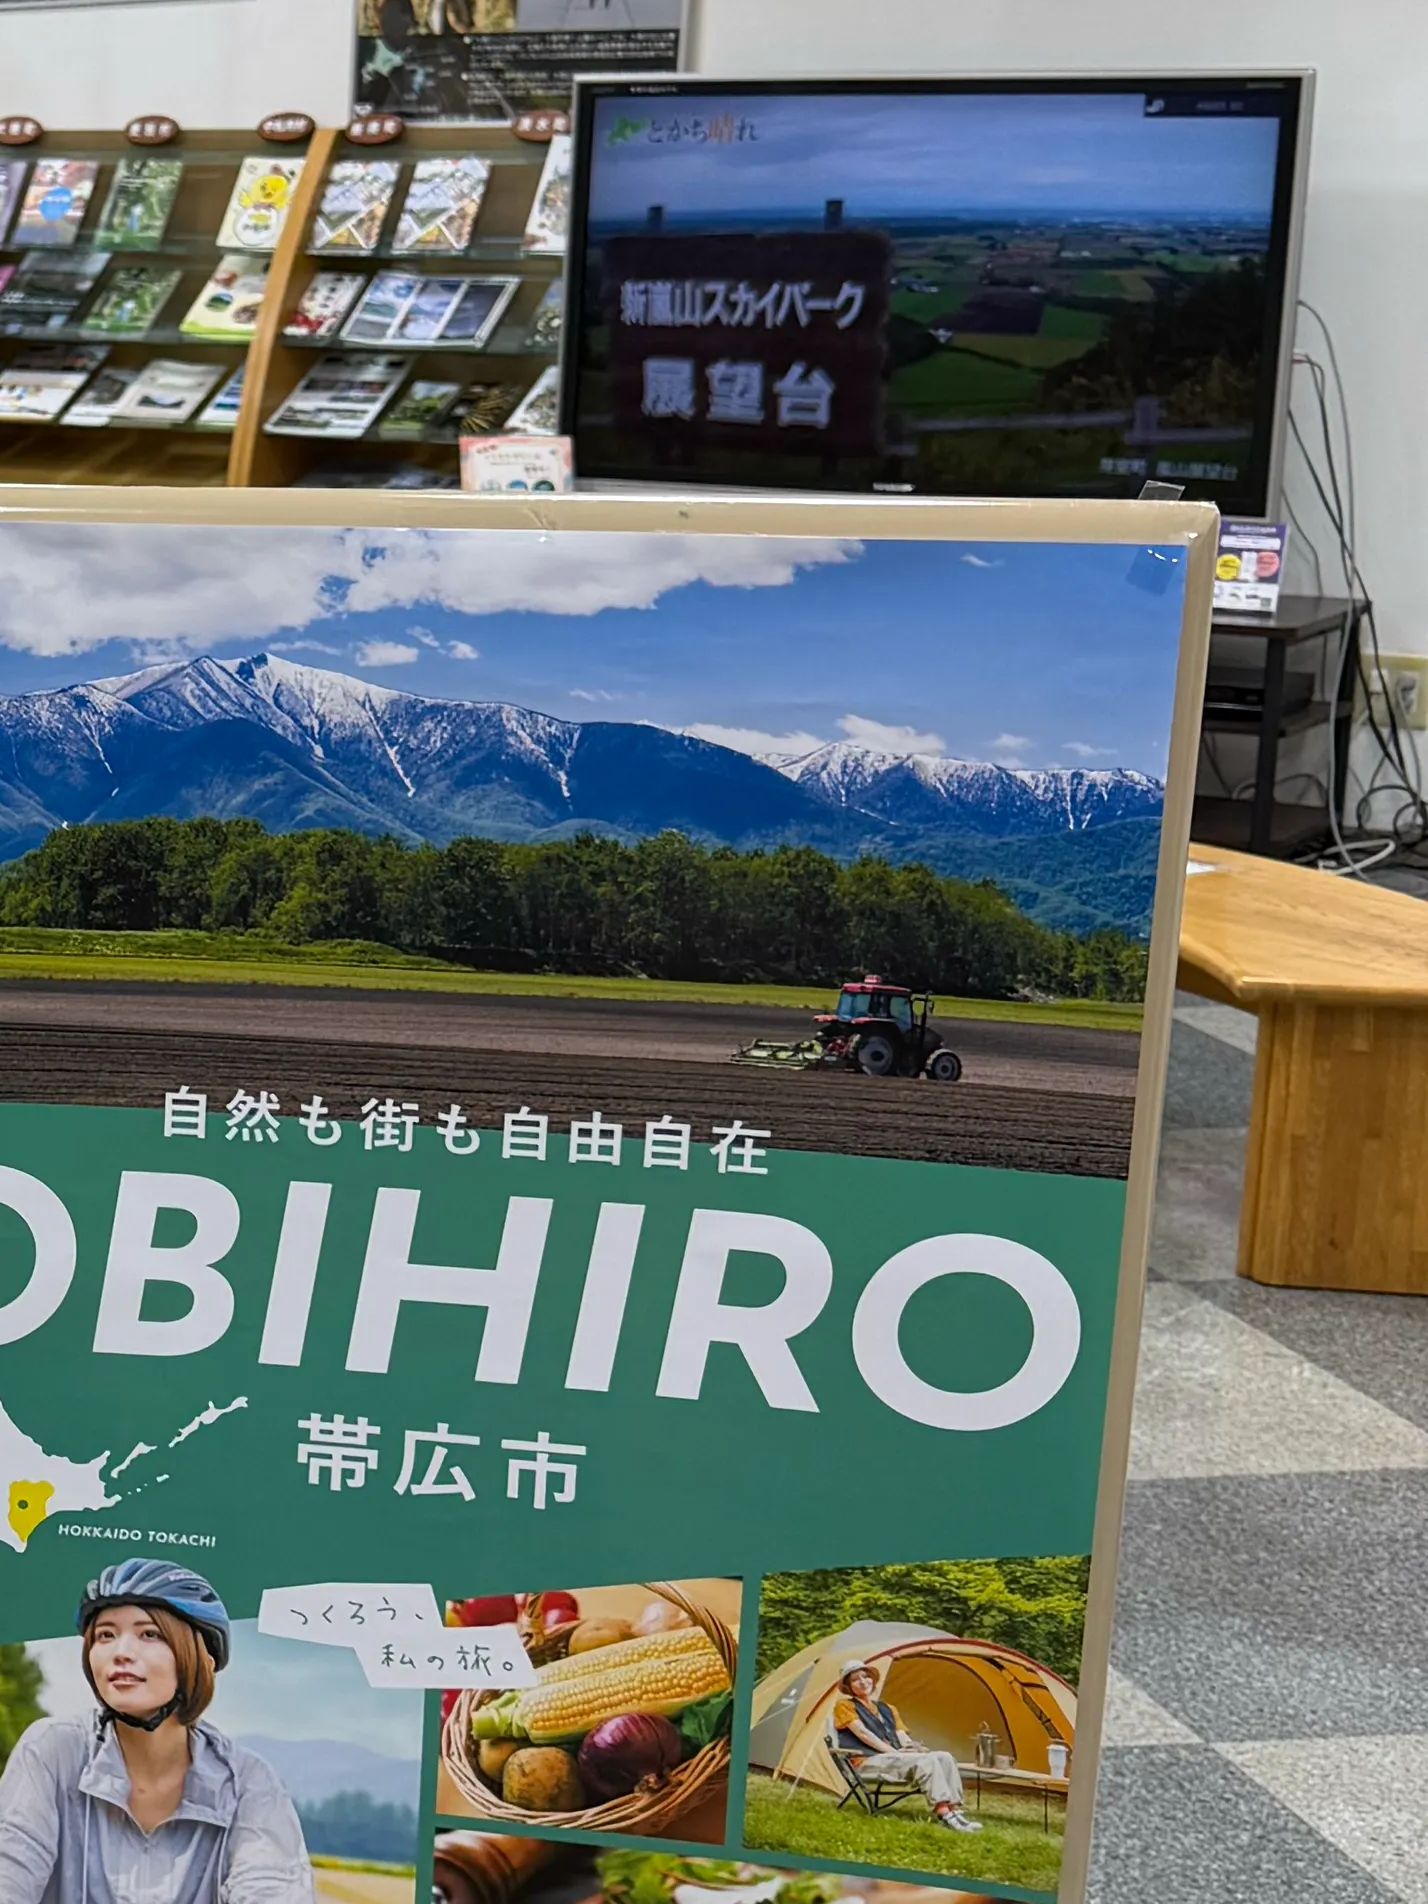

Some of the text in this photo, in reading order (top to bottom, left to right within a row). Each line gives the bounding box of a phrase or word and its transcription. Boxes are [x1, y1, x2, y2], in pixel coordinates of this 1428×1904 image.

[647, 112, 759, 144] とかち晴れ
[640, 356, 837, 429] 展望台
[161, 1085, 773, 1177] 自然も街も自由自在
[294, 1413, 589, 1512] 帯広市
[57, 1523, 217, 1548] HOKKAIDO TOKACHI
[381, 1643, 515, 1677] 私の旅。
